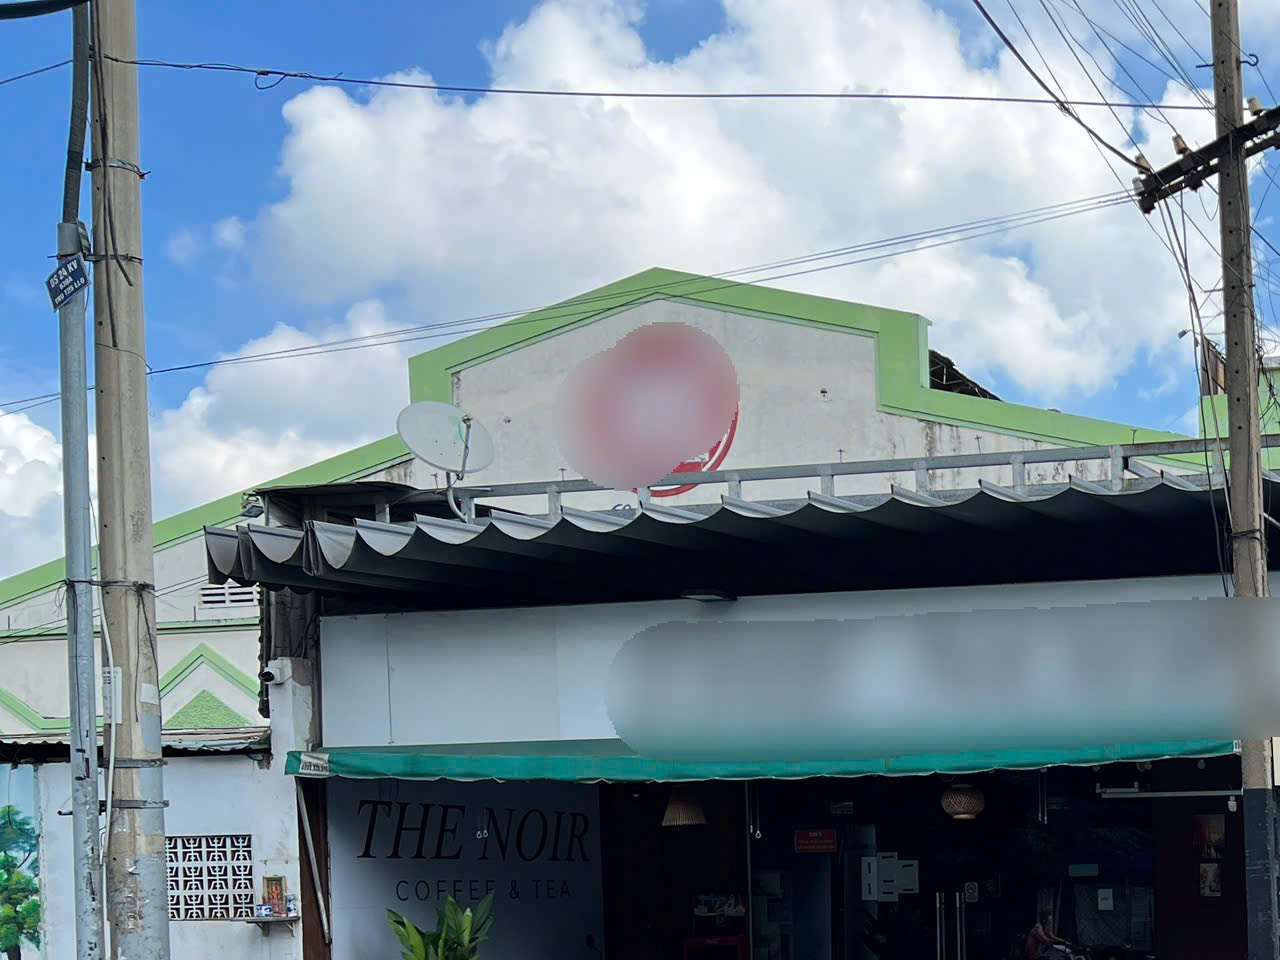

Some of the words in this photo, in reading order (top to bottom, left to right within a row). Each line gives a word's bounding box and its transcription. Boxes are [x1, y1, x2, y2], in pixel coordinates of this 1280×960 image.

[67, 260, 78, 272] KV
[357, 799, 466, 860] THE
[478, 807, 591, 862] NOIR
[396, 879, 496, 901] COFFEE
[509, 879, 521, 899] &
[532, 879, 573, 898] TEA
